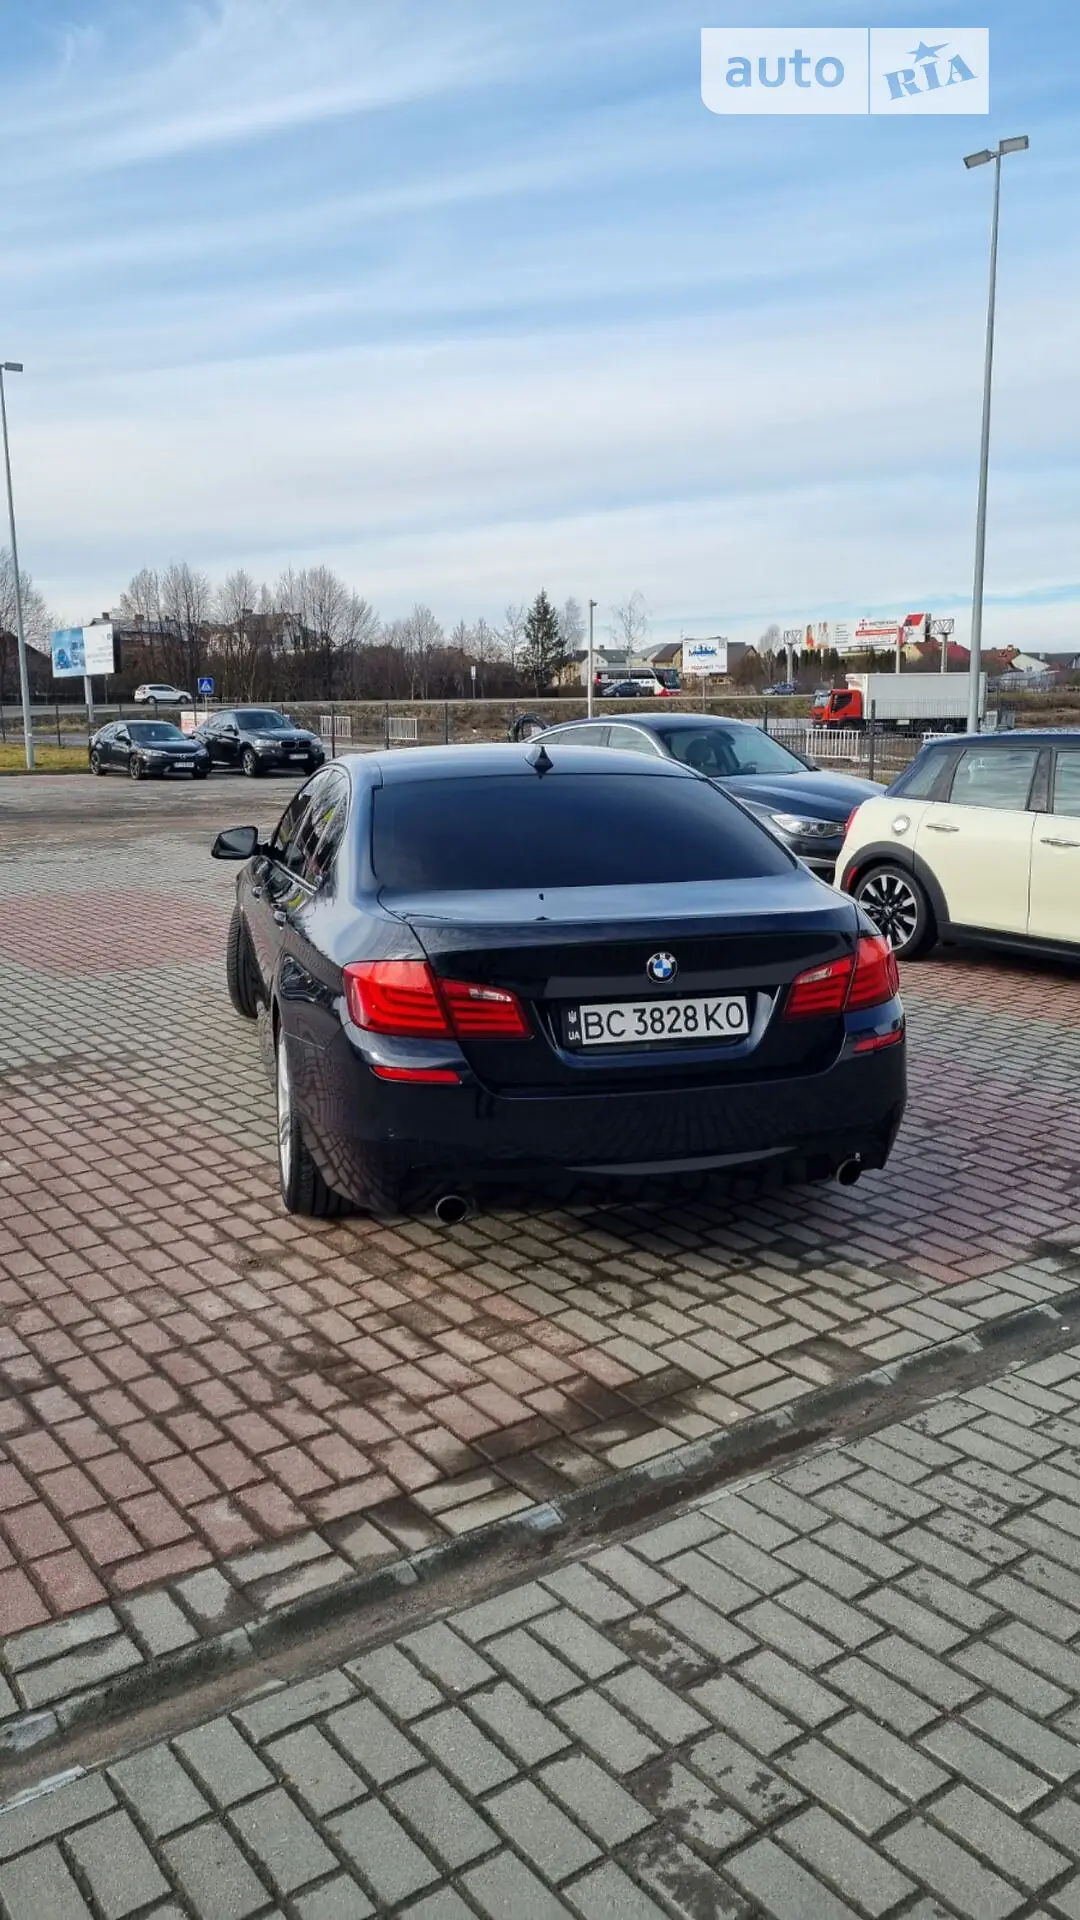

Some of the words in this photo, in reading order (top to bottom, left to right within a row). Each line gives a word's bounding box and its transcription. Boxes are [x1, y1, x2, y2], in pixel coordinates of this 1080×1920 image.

[583, 1009, 626, 1040] BC
[632, 1004, 699, 1036] 3828
[703, 1002, 744, 1031] KO
[568, 1031, 581, 1041] UA
